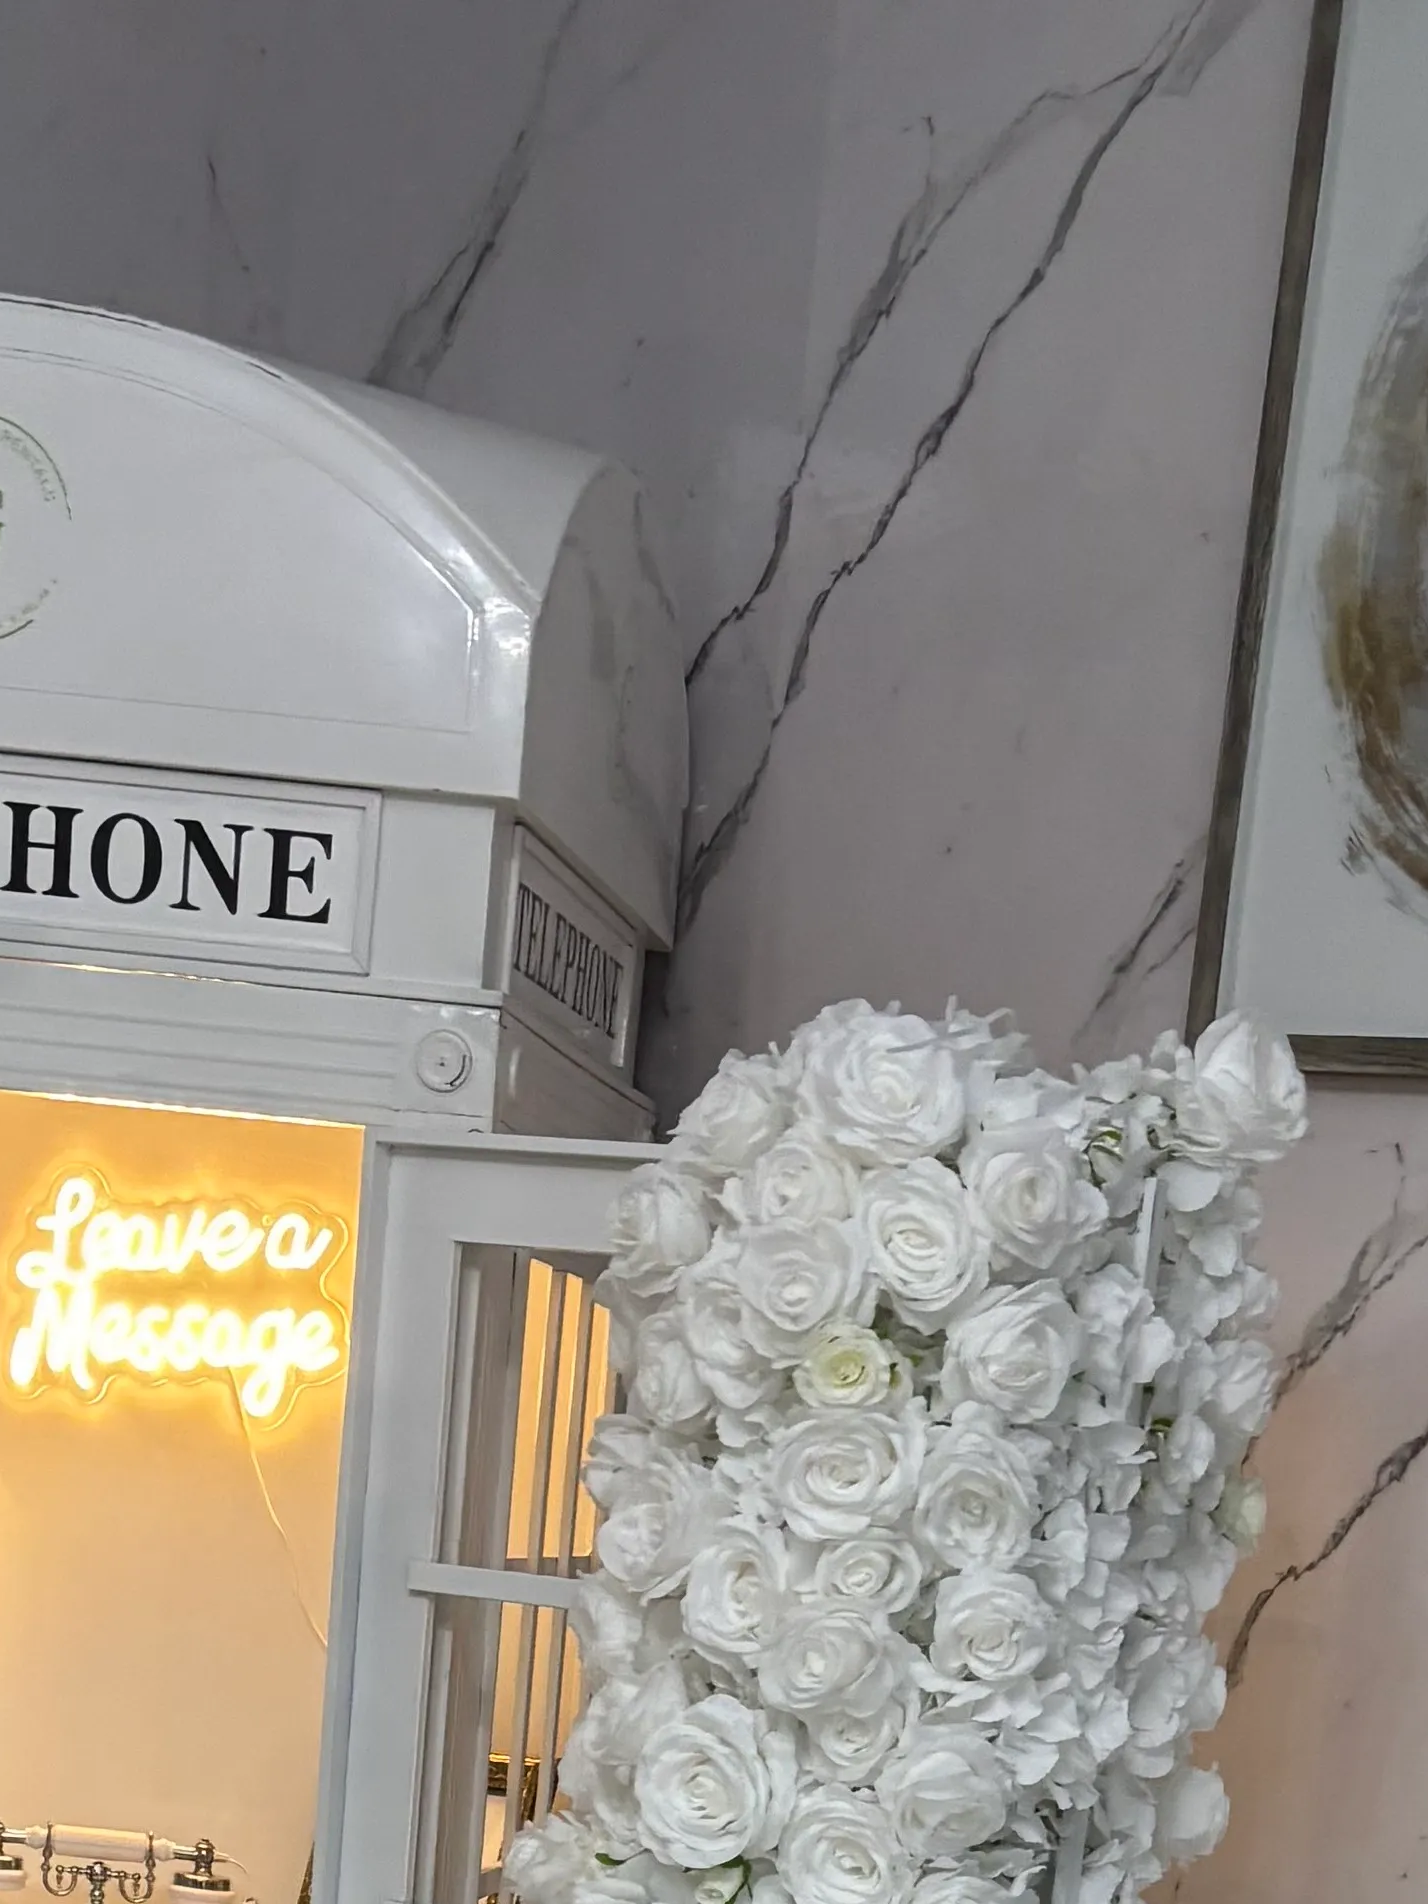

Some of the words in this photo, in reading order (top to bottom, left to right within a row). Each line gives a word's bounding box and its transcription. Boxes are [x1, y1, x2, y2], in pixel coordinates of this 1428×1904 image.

[514, 882, 623, 1039] TELEPHONE
[16, 1177, 264, 1290] Leave
[265, 1213, 334, 1270] a
[9, 1275, 340, 1418] Message
